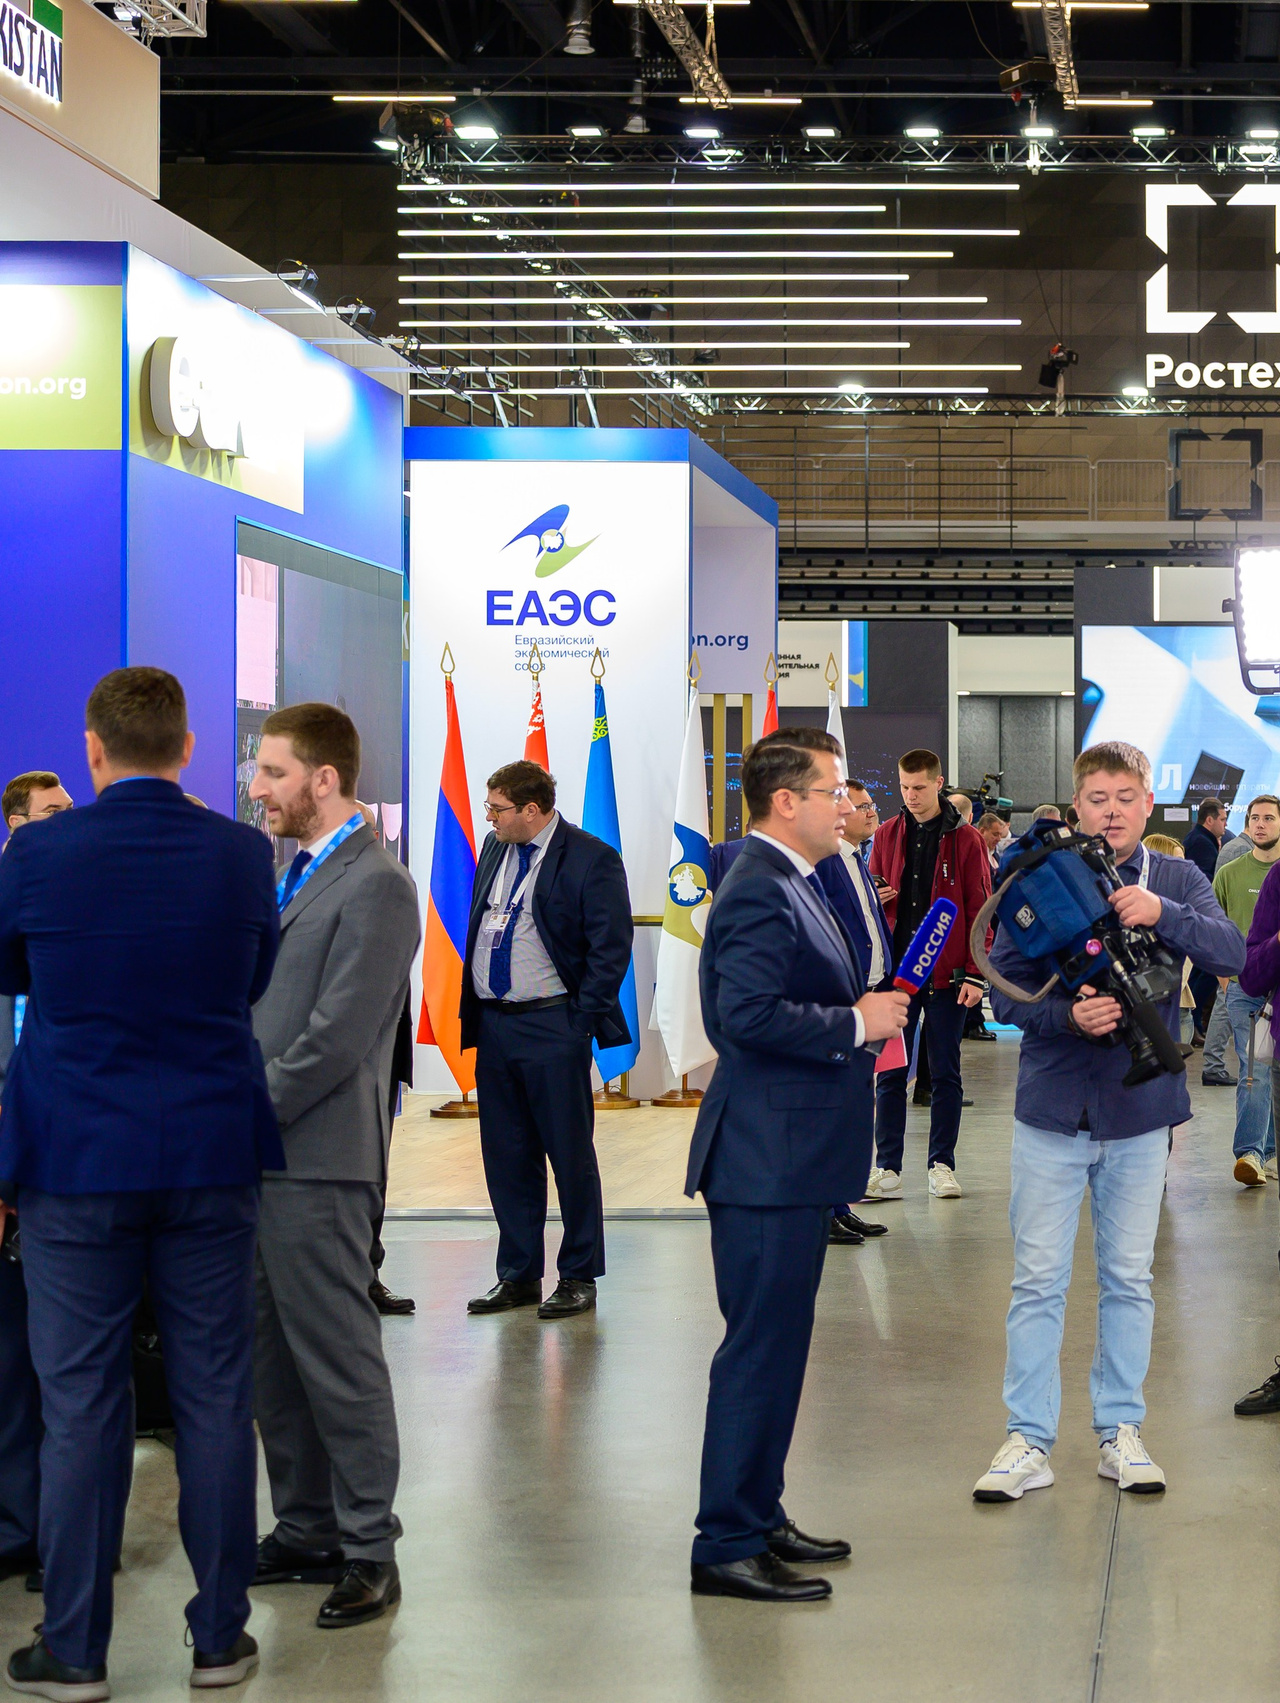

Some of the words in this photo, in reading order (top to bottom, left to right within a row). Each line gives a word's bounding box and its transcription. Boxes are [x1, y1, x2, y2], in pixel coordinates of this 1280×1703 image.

[486, 589, 617, 627] ЕАЭС
[514, 634, 595, 647] Евразийский
[691, 634, 749, 651] n.org
[912, 911, 952, 978] РОССИЯ
